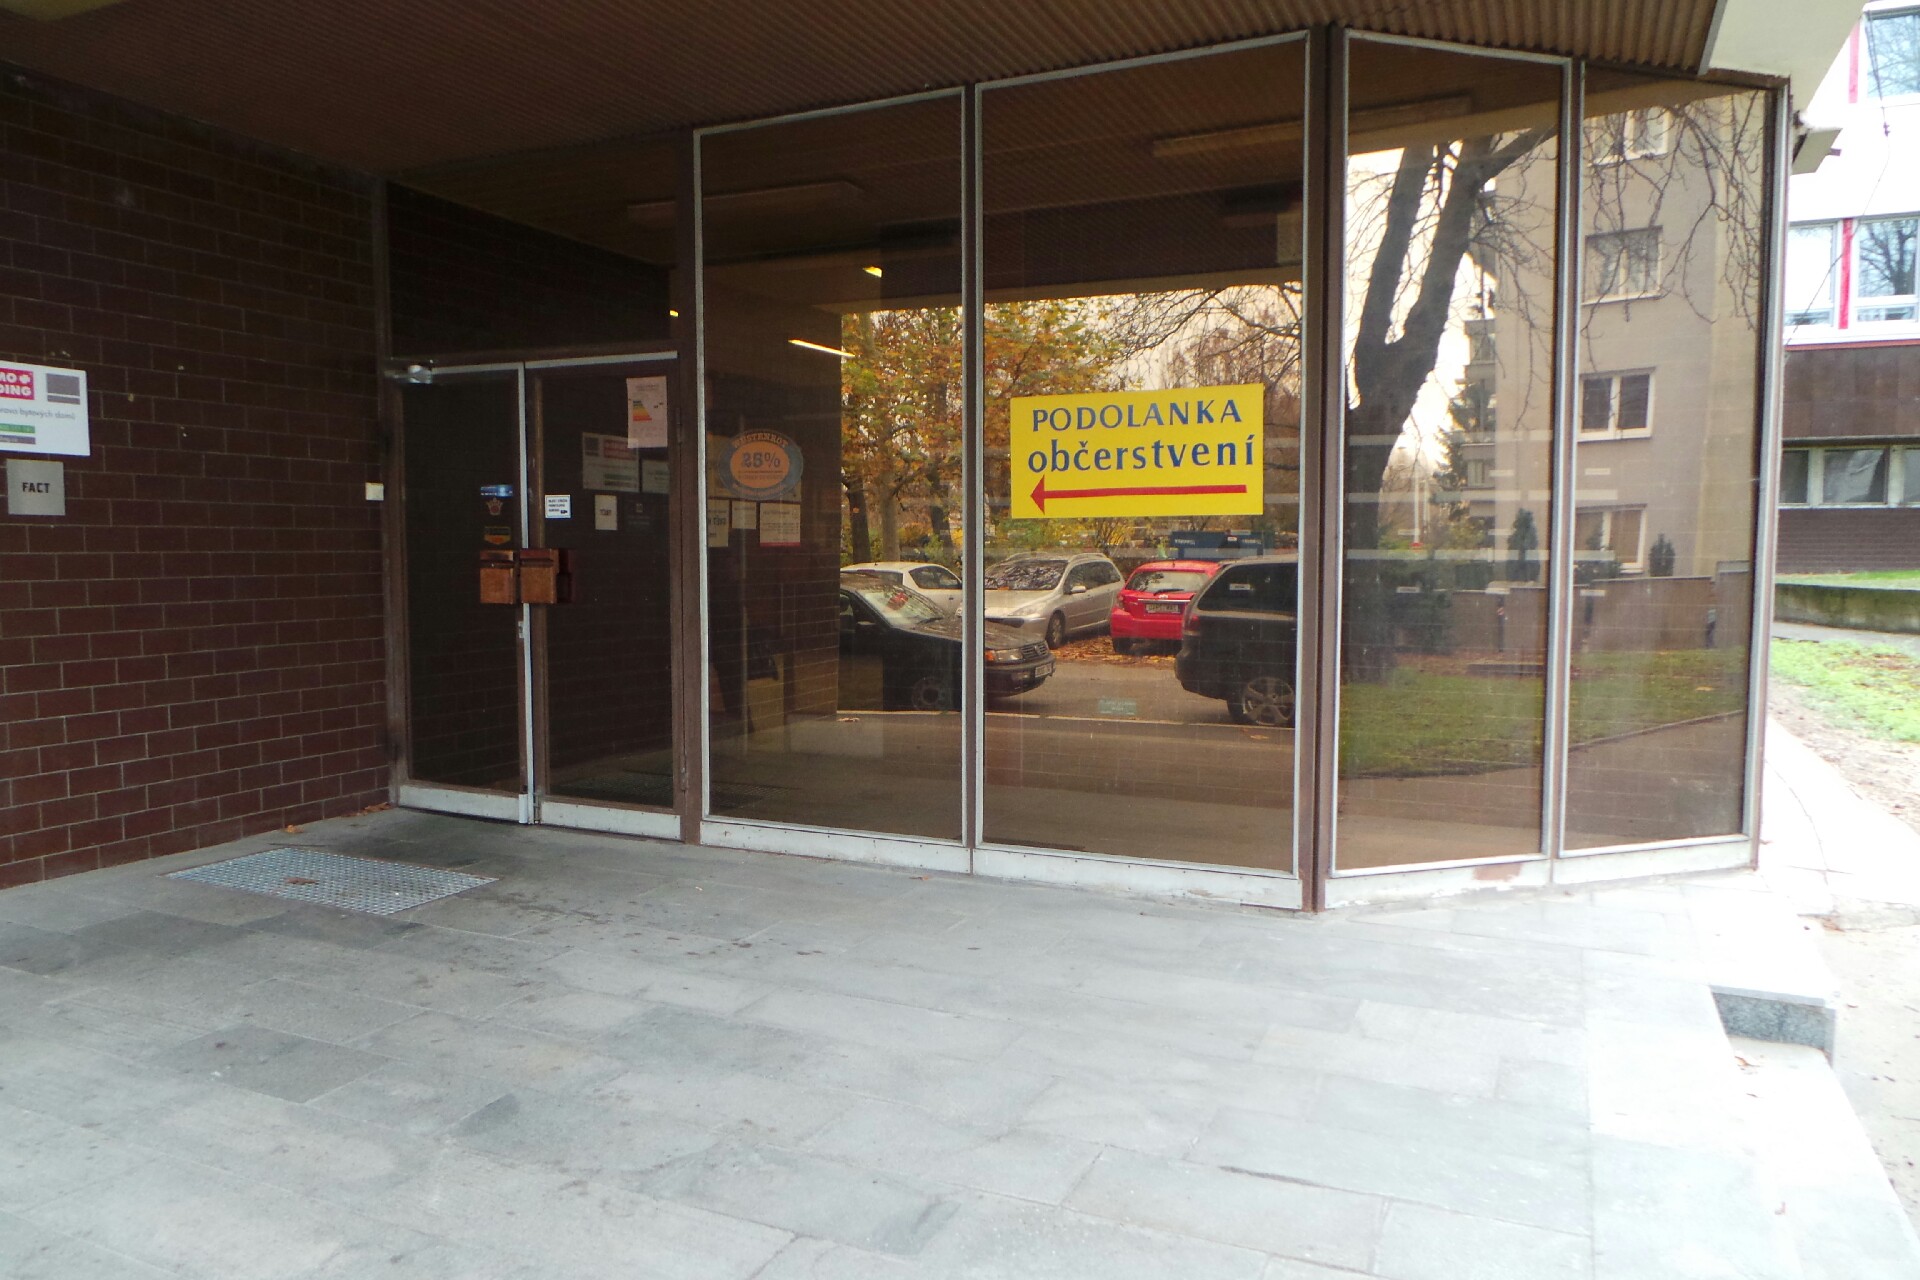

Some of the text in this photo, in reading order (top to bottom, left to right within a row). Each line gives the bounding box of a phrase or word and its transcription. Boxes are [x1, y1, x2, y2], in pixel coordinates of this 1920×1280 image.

[1032, 399, 1242, 432] PODOLANKA
[1028, 434, 1255, 473] občerstvení
[22, 482, 50, 493] FACT
